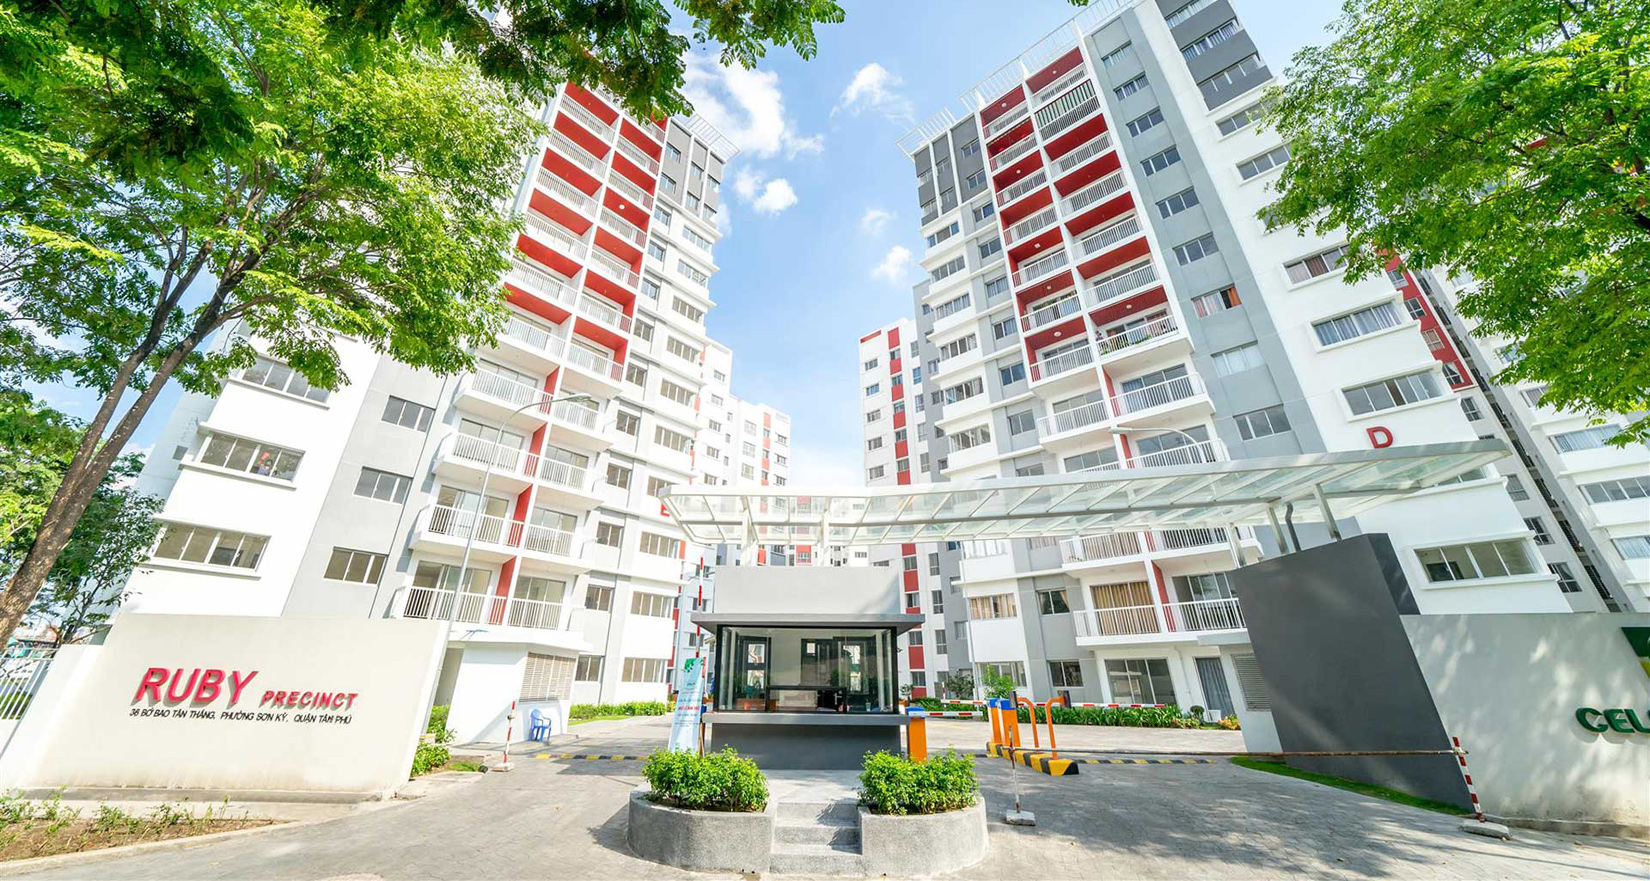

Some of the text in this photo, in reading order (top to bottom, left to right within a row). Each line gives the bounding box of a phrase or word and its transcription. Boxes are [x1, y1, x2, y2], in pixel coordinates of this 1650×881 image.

[1366, 426, 1394, 449] D
[132, 667, 358, 709] RUBY PRECINCT
[129, 708, 140, 717] 36
[153, 709, 171, 718] BAO
